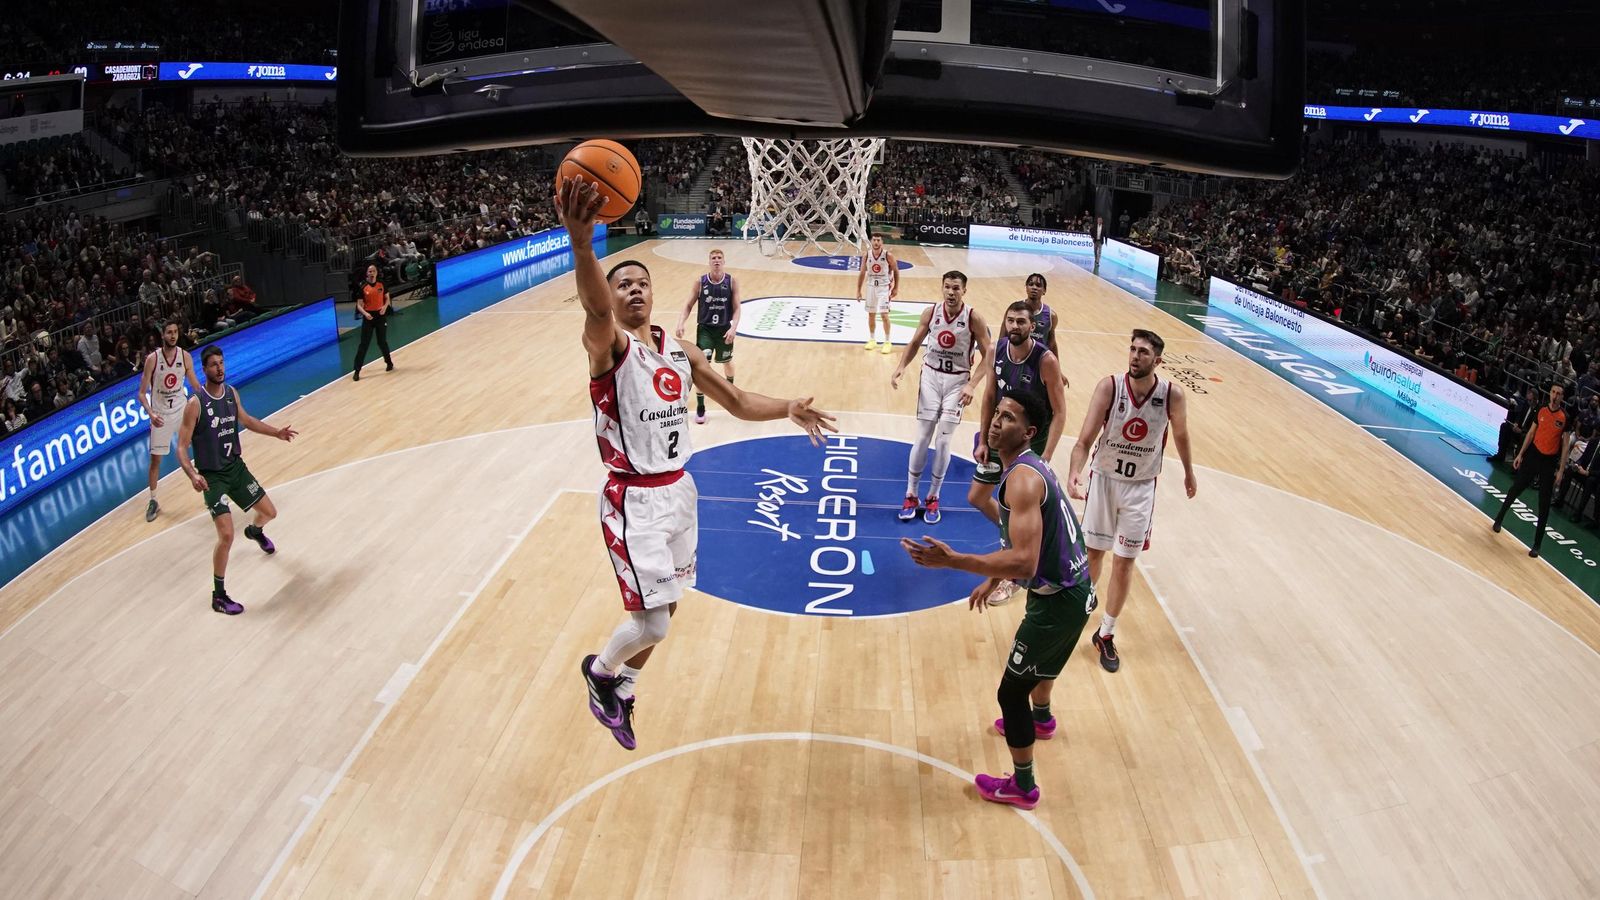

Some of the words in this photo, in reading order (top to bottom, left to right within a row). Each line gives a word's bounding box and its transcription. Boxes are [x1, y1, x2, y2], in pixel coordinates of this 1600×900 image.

[457, 37, 504, 51] endesa
[105, 65, 142, 75] CASADEMONT
[112, 73, 141, 82] ZARAGOZA
[1304, 106, 1327, 116] oma
[673, 217, 704, 226] Fundación
[673, 223, 696, 231] Unicaja
[920, 224, 967, 236] endesa
[1008, 233, 1019, 241] de
[1020, 234, 1050, 245] Unicaja
[1051, 237, 1094, 248] Baloncesto
[502, 234, 570, 267] www.famadesa.es
[712, 314, 720, 325] 9
[1234, 294, 1242, 306] de
[1242, 297, 1265, 318] Unicaja
[1265, 307, 1303, 334] Baloncesto
[938, 358, 953, 372] 19
[167, 398, 174, 409] 7
[223, 442, 233, 457] 7
[667, 430, 680, 460] 2
[1105, 439, 1156, 453] Casademont
[1114, 458, 1137, 478] 10
[747, 468, 810, 542] Resort
